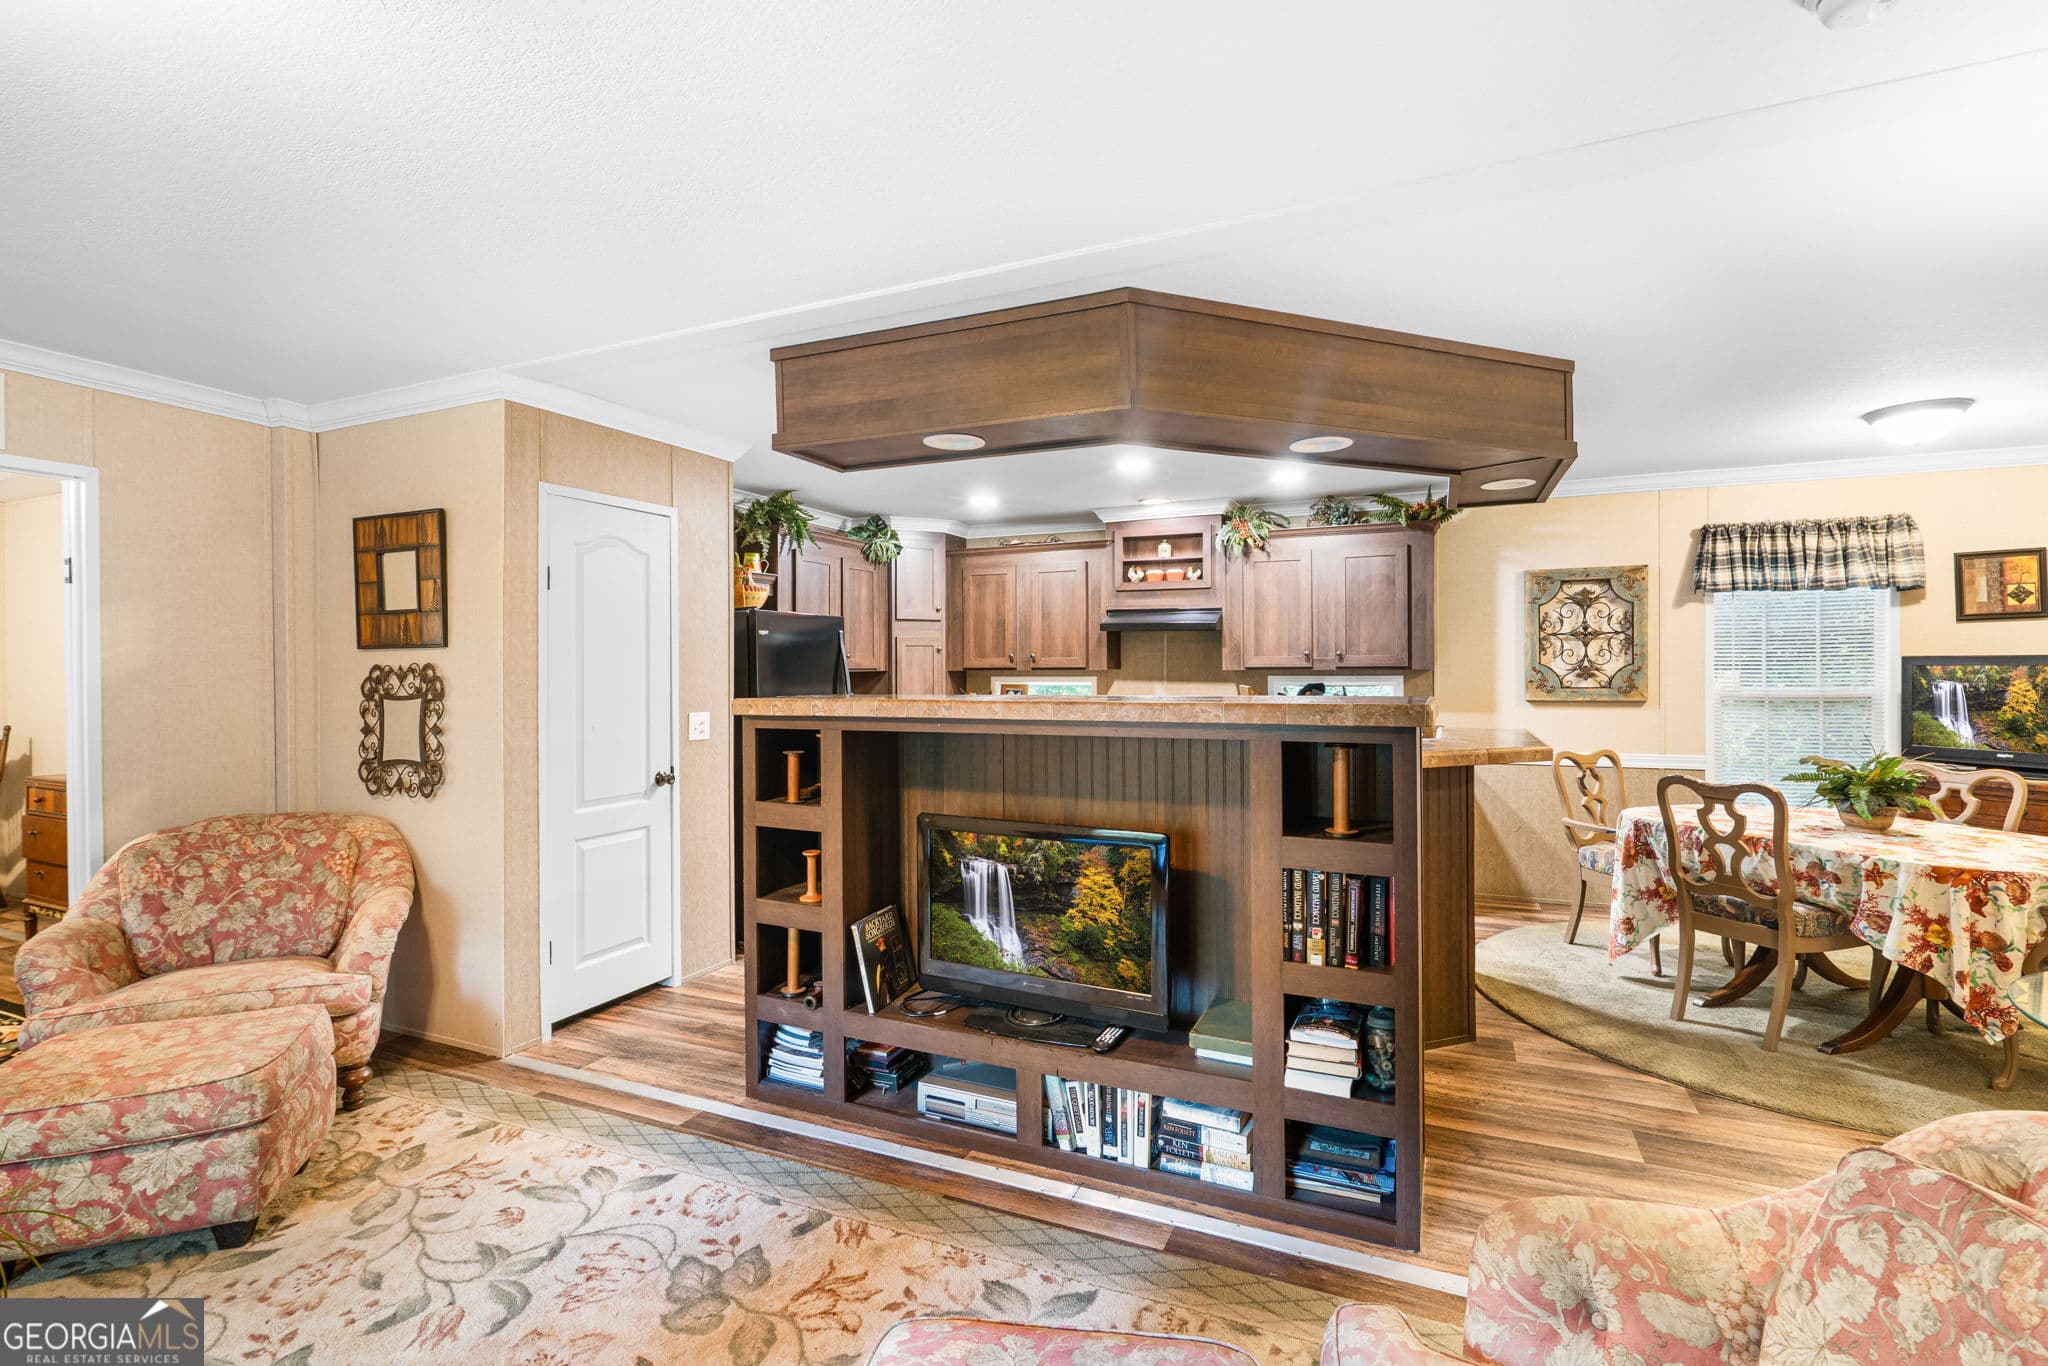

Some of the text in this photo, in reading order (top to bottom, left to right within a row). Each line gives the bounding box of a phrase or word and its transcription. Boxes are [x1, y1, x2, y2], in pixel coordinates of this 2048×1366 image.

[1294, 871, 1302, 920] DAVID BALDACCI
[1312, 873, 1320, 925] DAVID BALDACCI
[1331, 873, 1340, 918] DAVID BALDACCI
[865, 911, 894, 931] BACKYARD
[865, 919, 896, 941] SONGBIRDS
[1070, 1088, 1083, 1132] THE QUIET GAME
[1163, 1124, 1175, 1132] KEN
[1174, 1126, 1195, 1137] FOLLETT
[1165, 1145, 1195, 1158] FOLLETT
[1172, 1138, 1188, 1149] KEN
